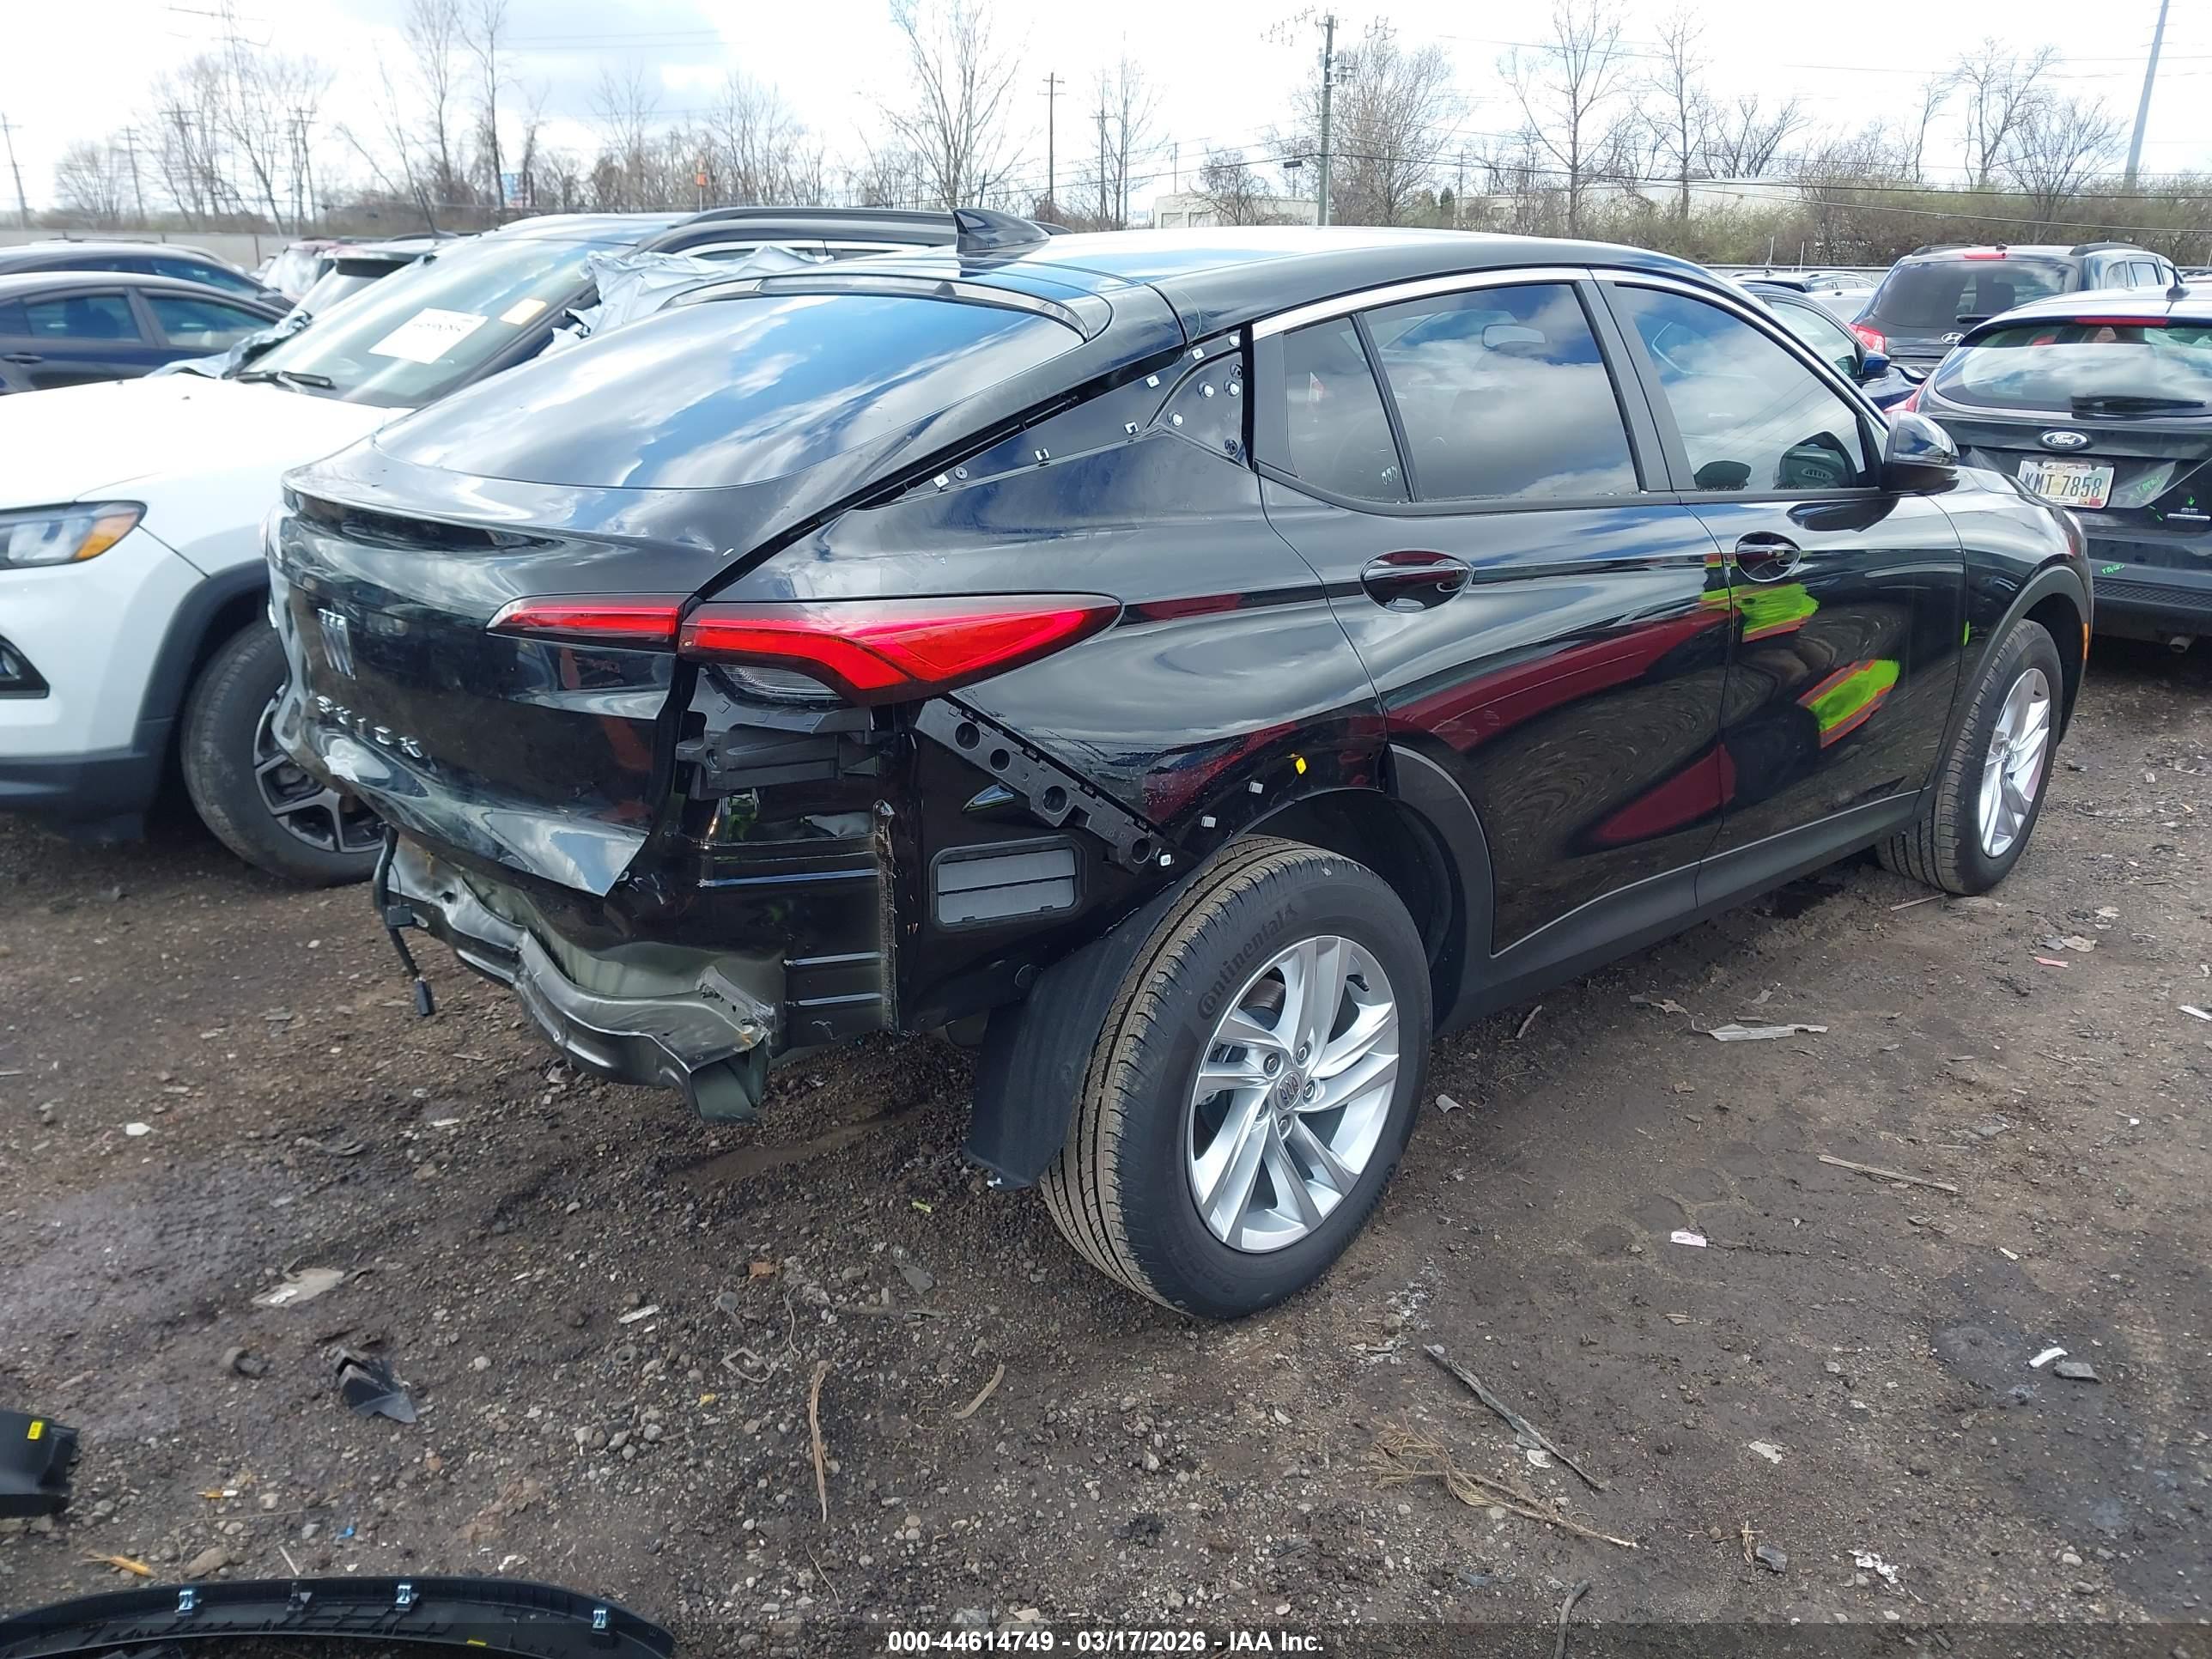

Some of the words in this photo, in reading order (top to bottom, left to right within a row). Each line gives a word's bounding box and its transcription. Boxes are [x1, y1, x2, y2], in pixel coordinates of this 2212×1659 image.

[2051, 433, 2078, 445] Ford
[2024, 471, 2056, 495] KMT
[2061, 475, 2103, 499] 7858
[316, 696, 424, 758] BUICK
[1197, 908, 1286, 1020] Continental
